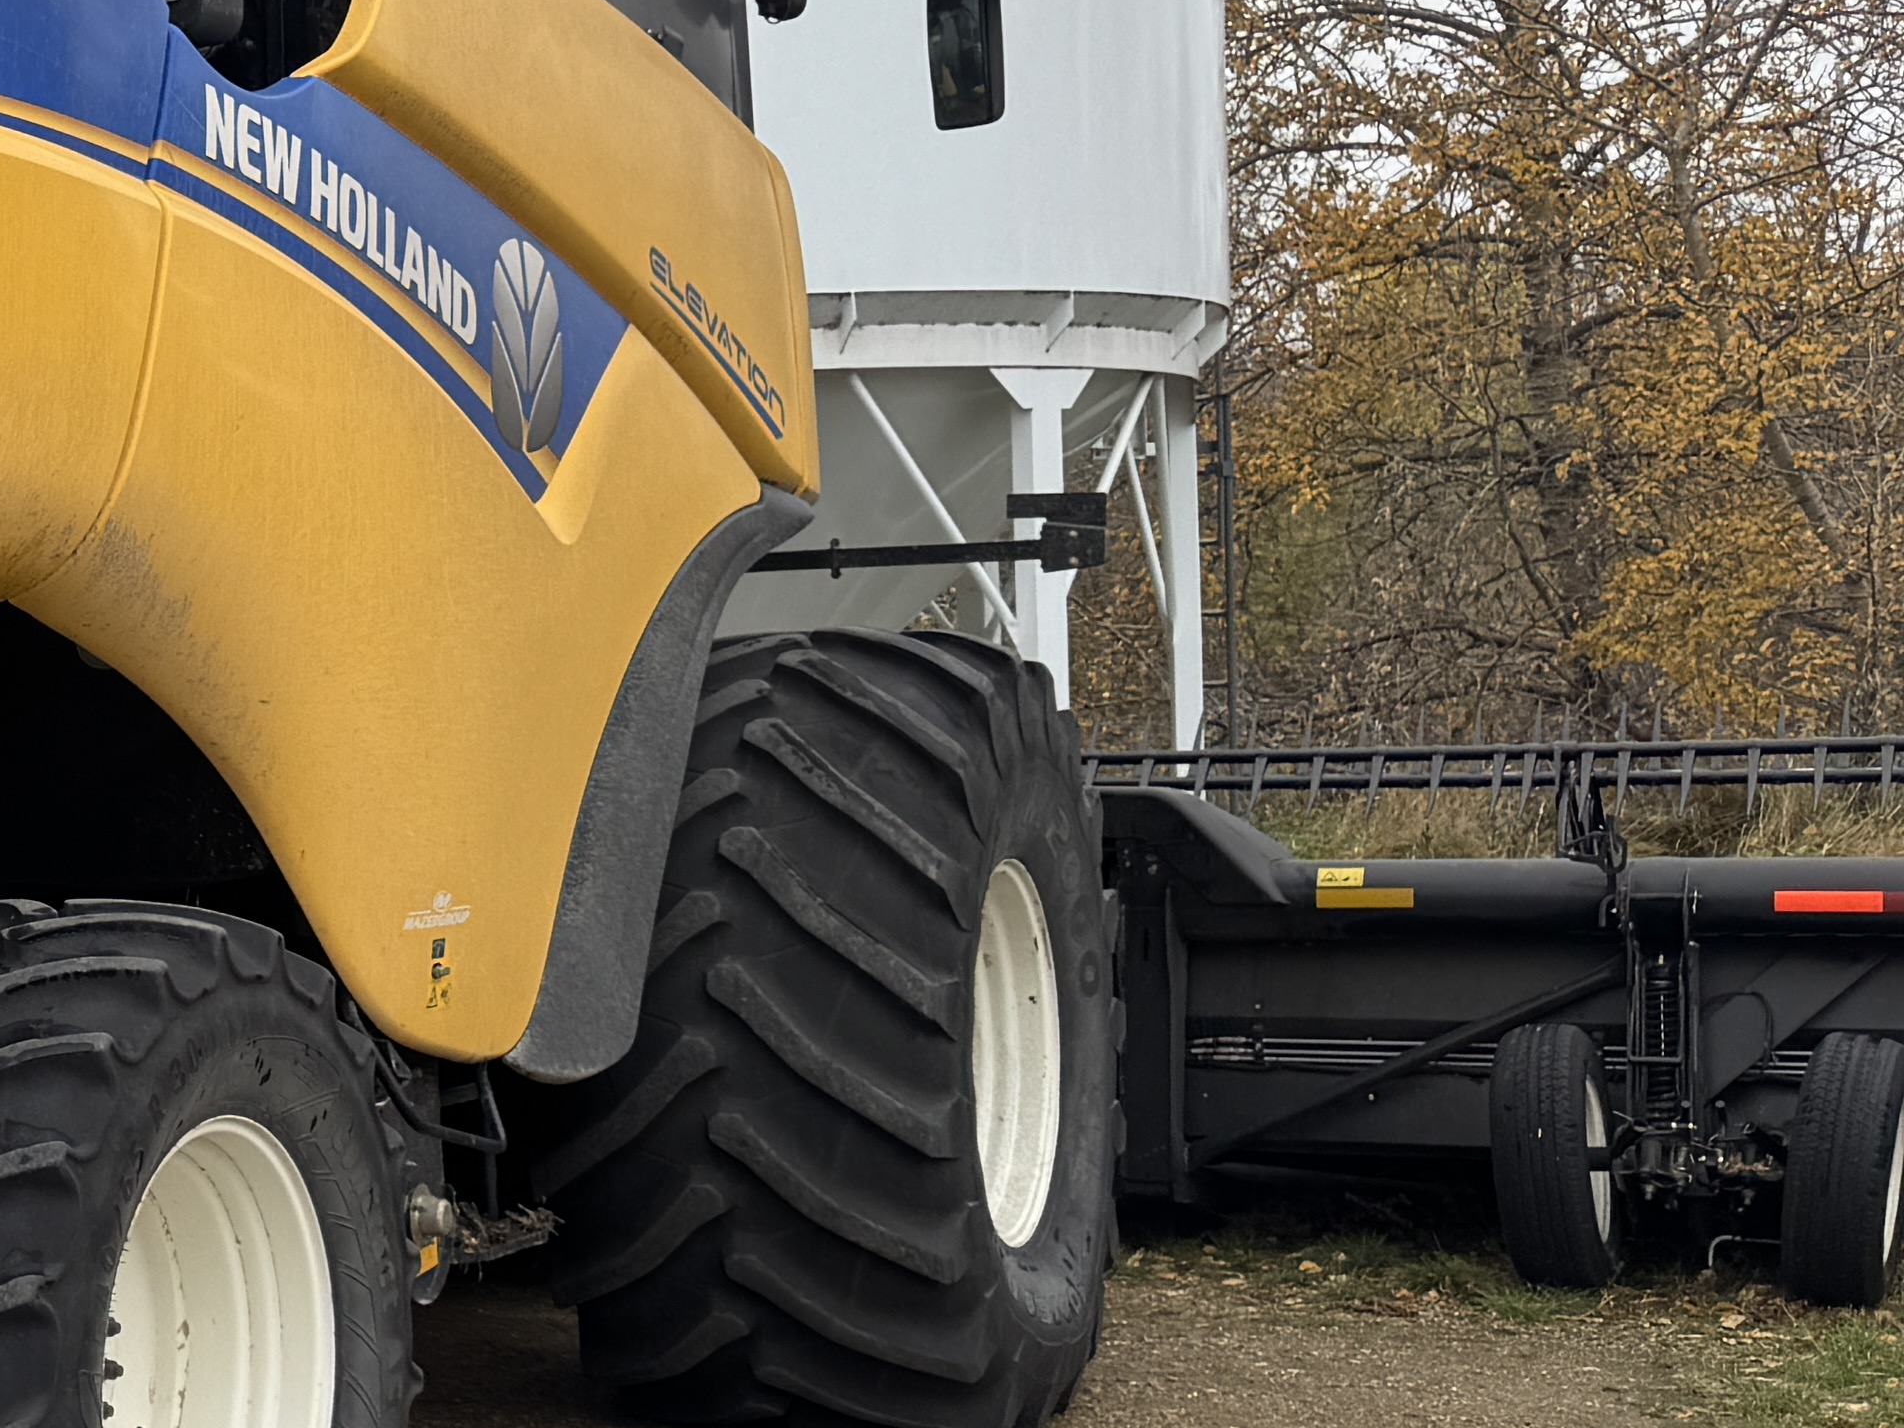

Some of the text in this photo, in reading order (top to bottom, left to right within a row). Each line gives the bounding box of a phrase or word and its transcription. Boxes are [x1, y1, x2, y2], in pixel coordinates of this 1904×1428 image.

[204, 83, 478, 346] NEW HOLLAND
[648, 246, 787, 427] ELEVATION
